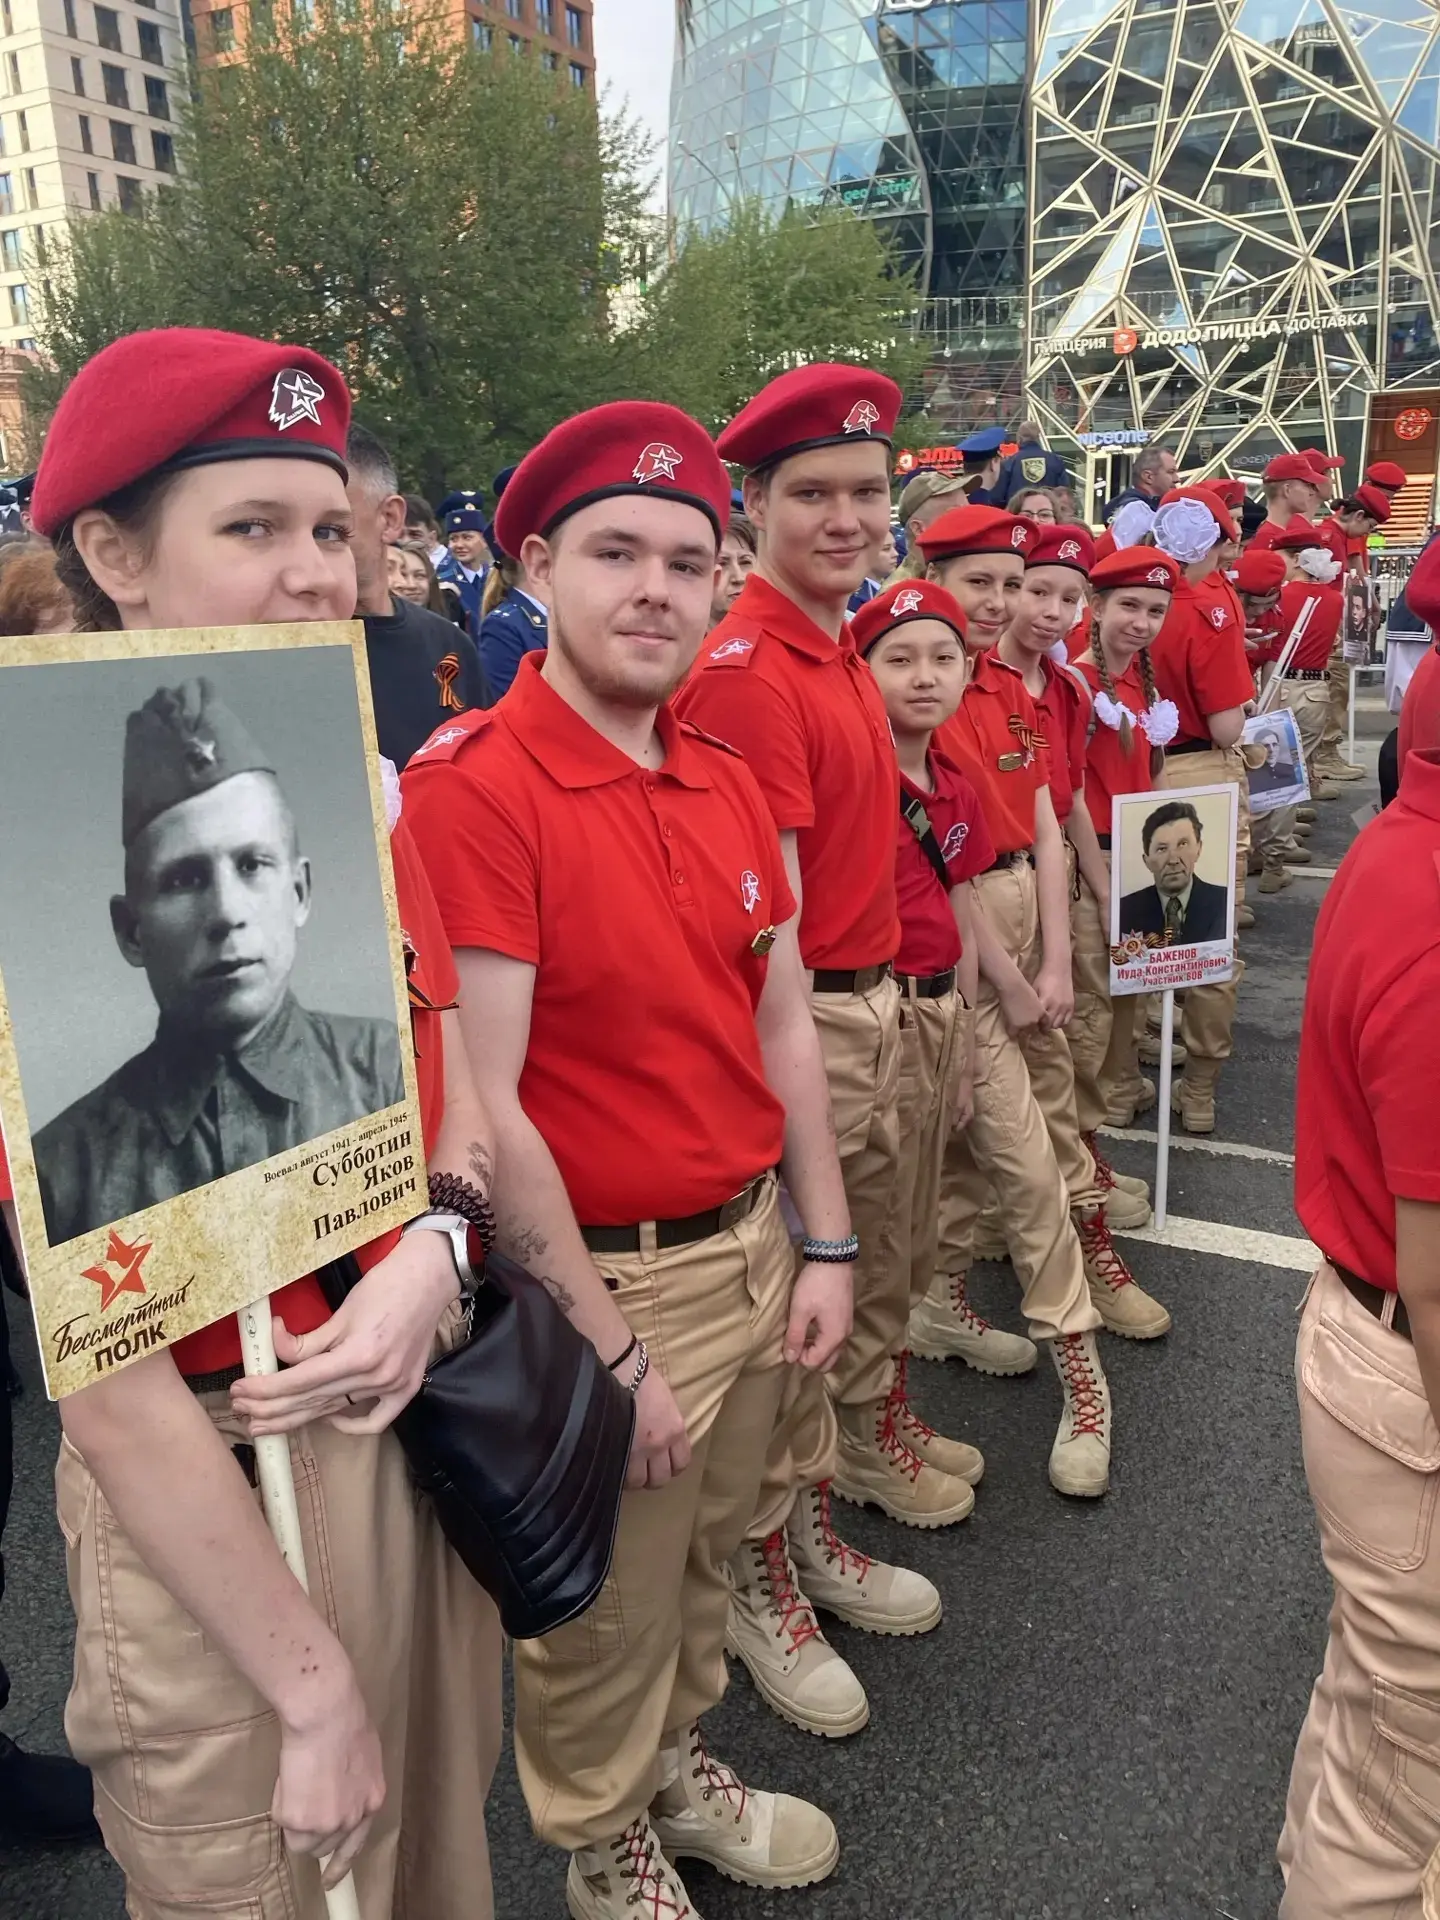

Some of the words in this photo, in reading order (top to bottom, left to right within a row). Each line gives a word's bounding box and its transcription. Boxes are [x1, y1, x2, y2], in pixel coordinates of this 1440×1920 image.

[1141, 327, 1203, 350] ДОДО
[1205, 319, 1282, 341] ПИЦЦА
[1288, 312, 1369, 333] ДОСТАВКА
[1117, 967, 1143, 980] Иуда
[1144, 956, 1227, 976] Константинович
[1149, 947, 1197, 964] БАЖЕНОВ
[1186, 970, 1203, 981] ВОВ
[264, 1163, 298, 1184] Воевал
[300, 1150, 329, 1168] август
[331, 1138, 351, 1153] 1941
[358, 1124, 388, 1141] апрель
[389, 1112, 408, 1128] 1945
[312, 1130, 411, 1186] Субботин
[363, 1155, 414, 1192] Яков
[312, 1177, 417, 1241] Павлович
[52, 1274, 196, 1364] Бессмертный
[94, 1320, 168, 1373] ПОЛК
